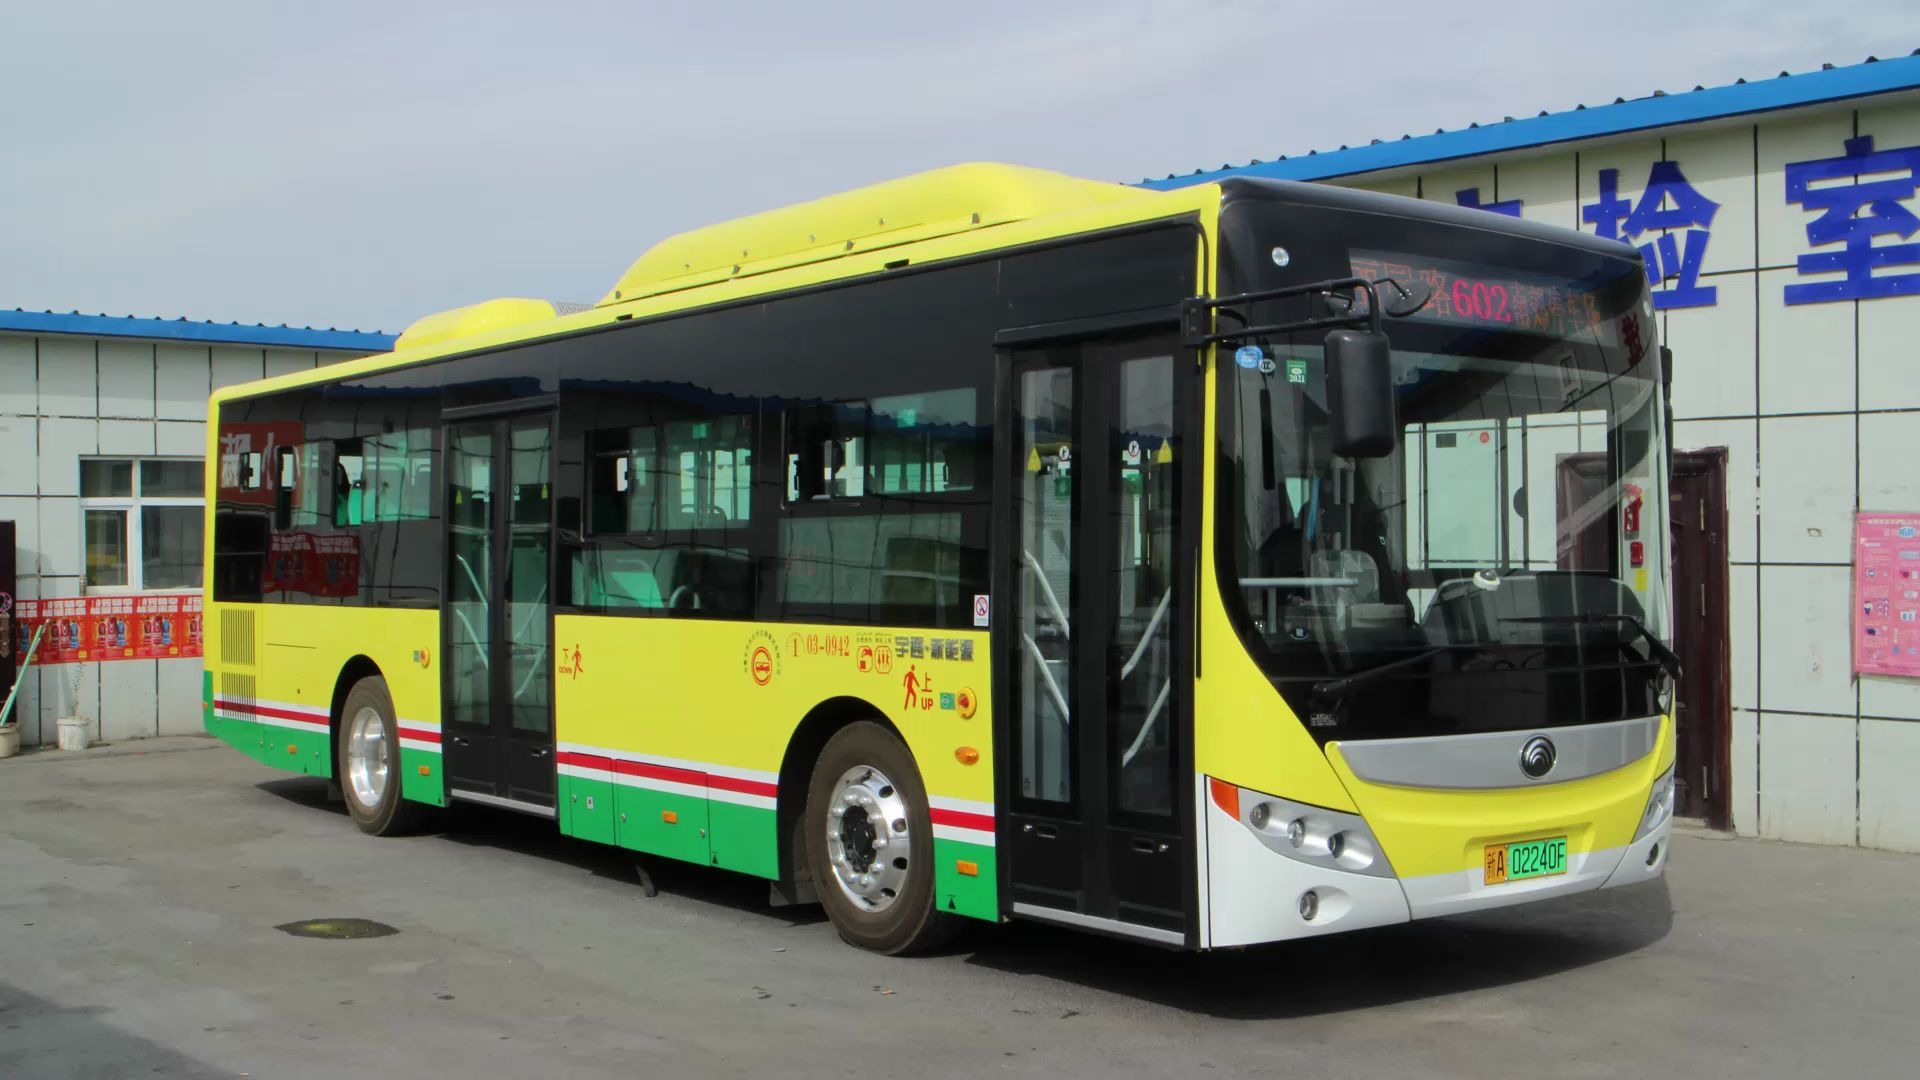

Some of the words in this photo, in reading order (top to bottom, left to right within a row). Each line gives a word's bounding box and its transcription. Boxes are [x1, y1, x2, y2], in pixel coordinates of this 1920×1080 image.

[1452, 279, 1512, 323] 602
[1289, 375, 1305, 383] 2021
[806, 634, 850, 657] 03-0942
[921, 672, 932, 693] 上
[921, 698, 933, 710] UP
